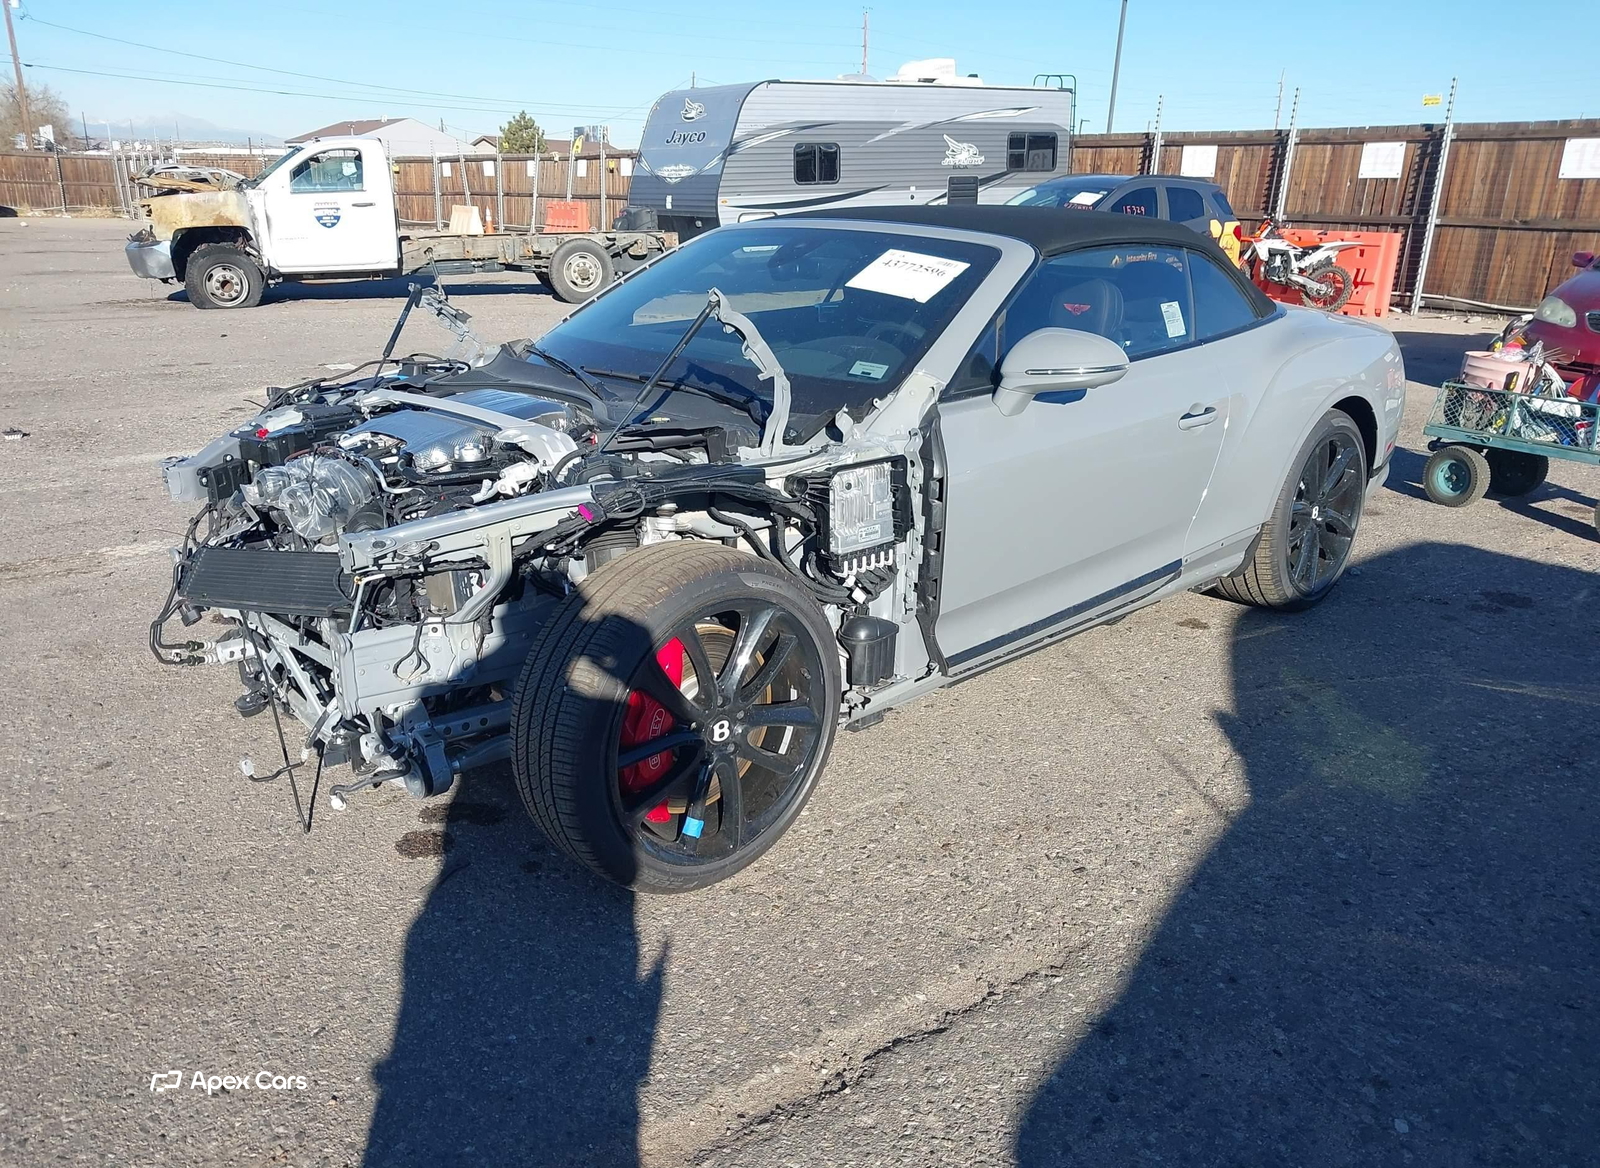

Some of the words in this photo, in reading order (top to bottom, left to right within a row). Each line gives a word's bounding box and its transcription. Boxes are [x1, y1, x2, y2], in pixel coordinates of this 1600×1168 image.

[665, 129, 706, 147] Jayco
[651, 715, 662, 765] BLEY
[712, 719, 731, 743] B
